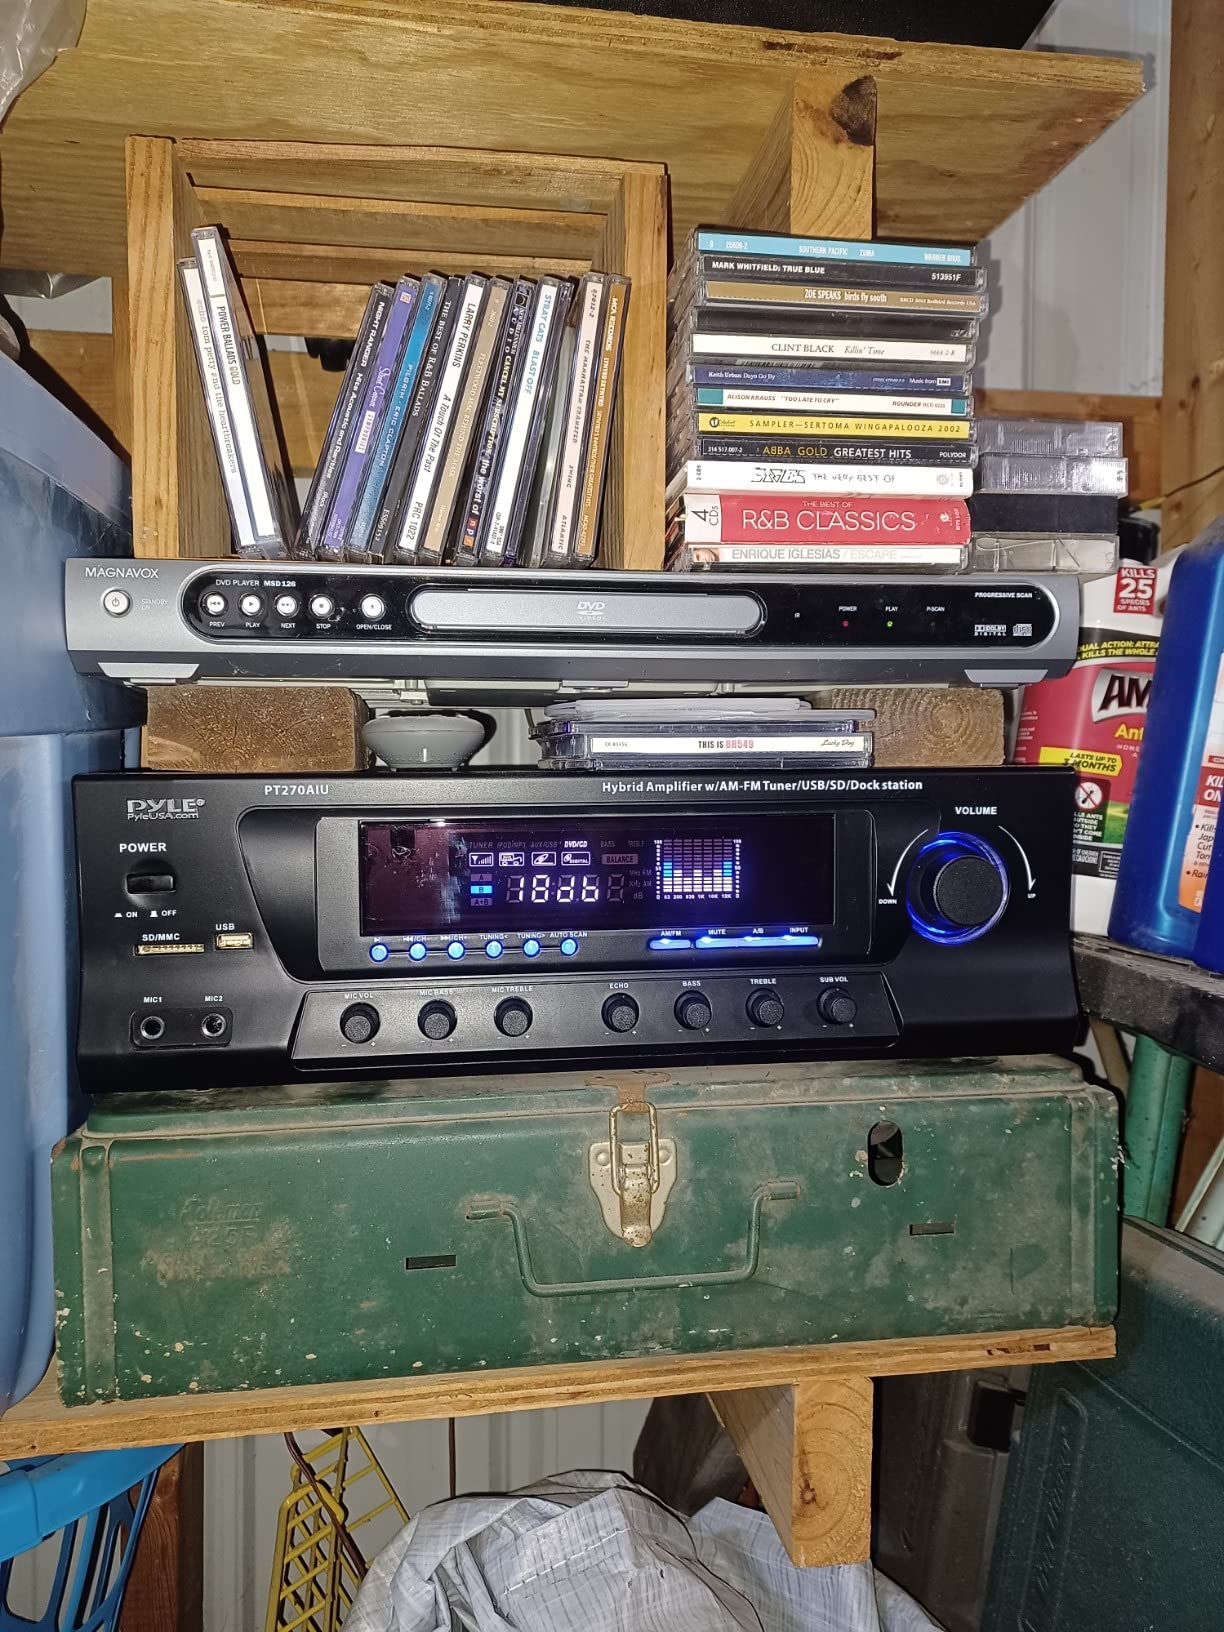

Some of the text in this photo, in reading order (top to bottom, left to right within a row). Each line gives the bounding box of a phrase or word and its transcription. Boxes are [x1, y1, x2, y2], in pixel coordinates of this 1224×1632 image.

[712, 261, 735, 269] MARK
[736, 262, 781, 272] WHITFIELD:
[782, 265, 803, 273] TRUE
[804, 266, 825, 274] BLUE
[805, 289, 887, 303] ZOE SPEAKS birds fly south
[441, 299, 451, 318] THE
[461, 302, 476, 330] LARRY
[434, 319, 445, 341] BEST
[605, 315, 615, 351] RECORDS
[216, 305, 240, 384] POWER BALLADS GOLD
[430, 342, 438, 354] OF
[451, 331, 468, 368] PERKINS
[524, 294, 551, 393] STRAY CATS BLAST OFF
[771, 343, 885, 355] CLINT BLACK Killin' Time
[423, 355, 436, 377] R&B
[469, 352, 486, 396] FLEETWOOD
[500, 355, 512, 382] CANCEL
[577, 355, 588, 403] MANHATTAN
[325, 301, 384, 478] NIGHT RANGER Hits Acoustic and Rarities
[201, 325, 237, 473] tom petty and the heartbreakers
[378, 363, 413, 466] PILGRIM ERIC CLAPTON
[435, 402, 449, 425] Touch
[433, 426, 443, 437] Of
[457, 414, 470, 441] BEHIND
[855, 423, 960, 433] WINGAPALOOZA 2002
[428, 437, 440, 453] The
[453, 443, 462, 457] THE
[763, 446, 791, 455] ABBA
[798, 447, 827, 456] GOLD
[833, 448, 886, 458] GREATEST
[889, 449, 911, 459] HITS
[423, 453, 435, 472] Past
[479, 459, 489, 475] the
[473, 476, 486, 502] worst
[411, 501, 423, 519] PRC
[471, 503, 480, 515] of
[691, 505, 719, 526] 4 CDs
[742, 509, 916, 531] R&B CLASSICS
[405, 520, 418, 540] 1022
[732, 549, 897, 560] ENRIQUE IGLESIAS ESCAPE
[85, 567, 159, 579] MAGNAVOX
[1120, 567, 1155, 579] KILLS
[1119, 579, 1153, 600] 25
[577, 601, 605, 611] DVD
[1082, 649, 1106, 658] KILLS
[1125, 648, 1155, 656] WHOLE
[1101, 641, 1134, 649] ACTION:
[725, 740, 754, 748] BR549
[264, 785, 329, 796] PT270AIU
[602, 781, 644, 794] Hybrid
[646, 781, 703, 794] Amplifier
[704, 781, 761, 792] w/AM-FM
[882, 779, 923, 790] station
[127, 812, 199, 821] PyleUSA.com
[955, 806, 998, 815] VOLUME
[119, 842, 167, 853] POWER
[564, 840, 588, 848] DVD/CD
[606, 856, 634, 864] BALANCE
[215, 923, 235, 931] USB
[142, 933, 180, 941] SD/MMC
[505, 985, 534, 993] TREBLE
